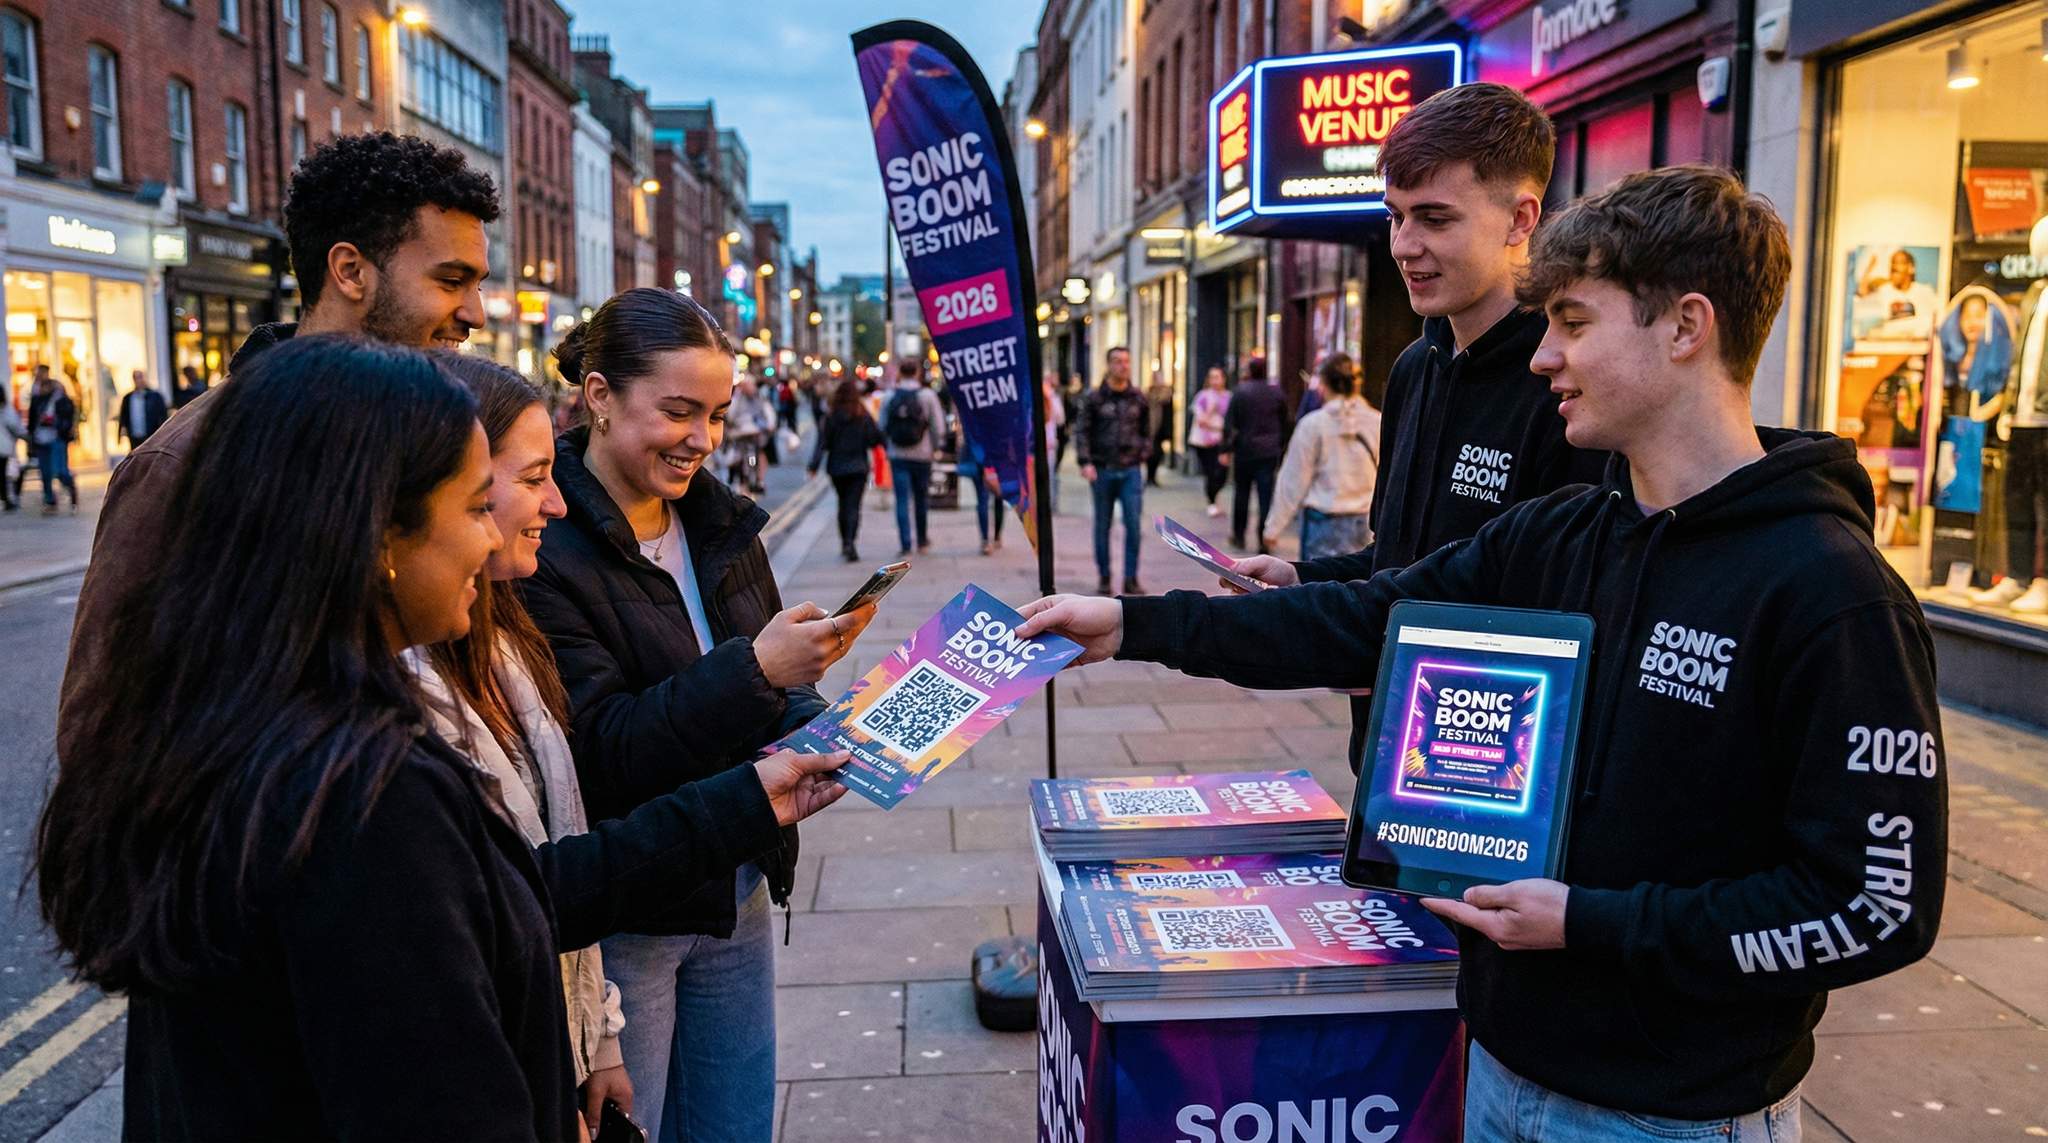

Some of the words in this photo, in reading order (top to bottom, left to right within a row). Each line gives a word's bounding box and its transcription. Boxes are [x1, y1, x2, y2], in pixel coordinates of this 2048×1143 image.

[1302, 69, 1411, 110] MUSIC
[886, 131, 984, 193] SONIC
[891, 169, 993, 232] BOOM
[899, 211, 1000, 260] FESTIVAL
[934, 282, 998, 325] 2026
[940, 336, 1018, 381] STREET
[959, 373, 1019, 411] TEAM
[1451, 461, 1509, 491] BOOM
[1458, 443, 1513, 471] SONIC
[1450, 481, 1502, 504] FESTIVAL
[945, 627, 1029, 680] BOOM
[966, 611, 1046, 661] SONIC
[1649, 621, 1738, 664] SONIC
[937, 648, 1000, 689] FESTIVAL
[1639, 645, 1730, 693] BOOM
[1437, 687, 1514, 713] SONIC
[1638, 673, 1715, 709] FESTIVAL
[1434, 706, 1511, 733] BOOM
[1437, 727, 1504, 746] FESTIVAL
[1847, 725, 1938, 779] 2026
[1230, 781, 1281, 815] BOOM
[1376, 820, 1530, 863] #SONICBOOM2026
[1296, 907, 1339, 948] FESTIVAL
[1313, 900, 1387, 951] BOOM
[1351, 898, 1425, 949] SONIC
[1174, 1093, 1401, 1143] SONIC
